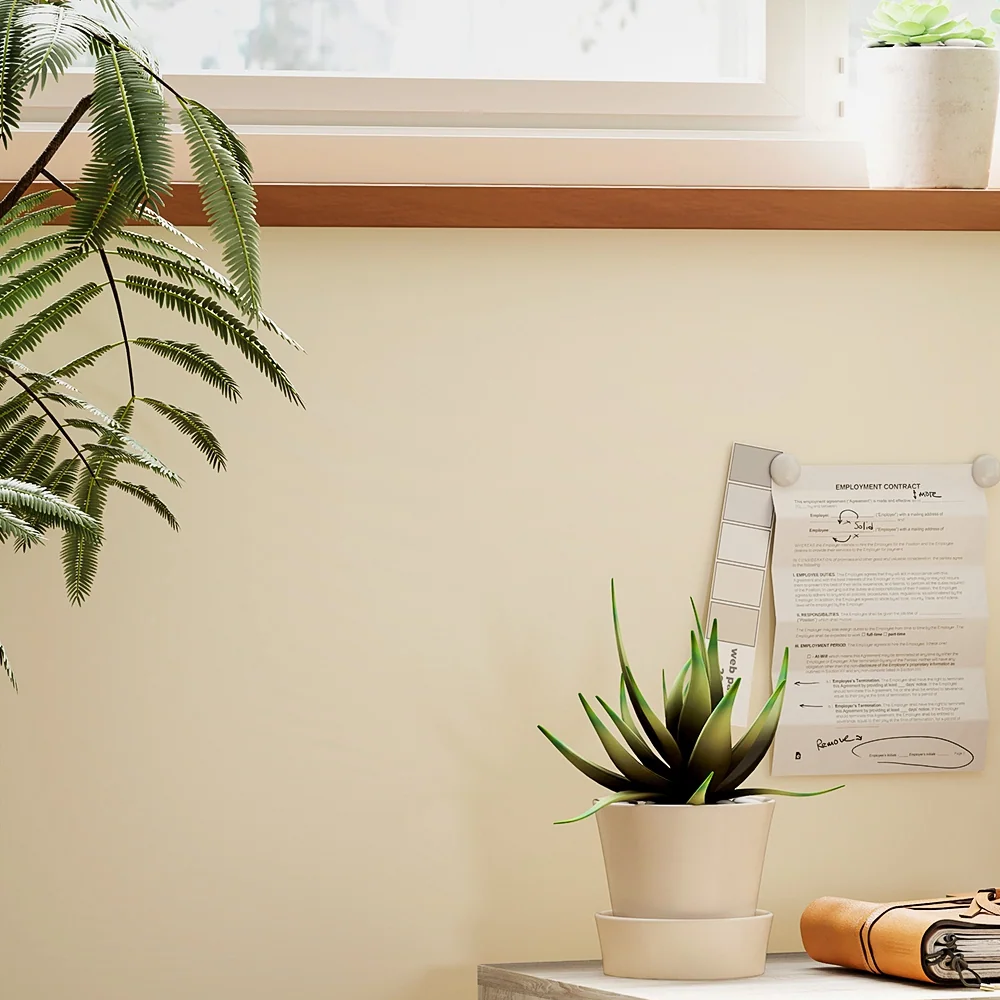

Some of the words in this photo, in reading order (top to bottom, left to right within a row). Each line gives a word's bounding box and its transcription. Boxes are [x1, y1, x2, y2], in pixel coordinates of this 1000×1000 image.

[835, 483, 882, 491] EMPLOYMENT
[854, 521, 874, 531] Solid
[729, 648, 738, 674] web
